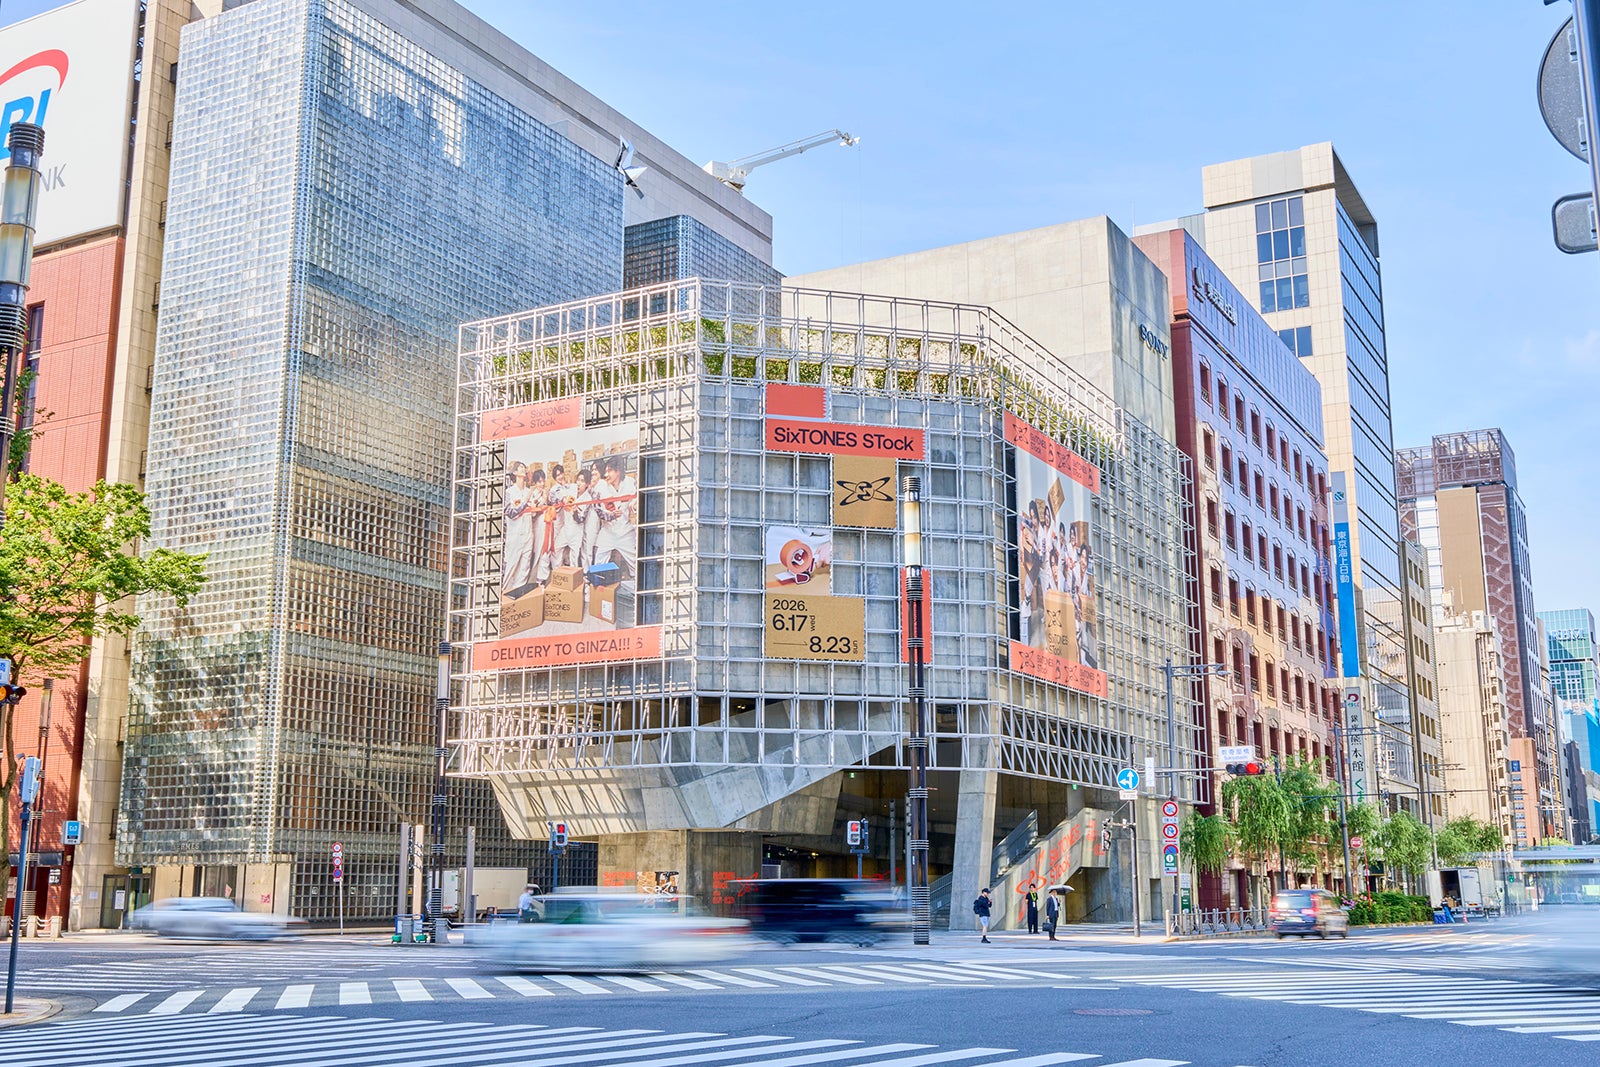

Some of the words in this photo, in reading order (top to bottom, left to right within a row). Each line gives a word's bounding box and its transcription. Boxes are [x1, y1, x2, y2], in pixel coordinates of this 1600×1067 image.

[1139, 323, 1168, 359] SONY
[530, 404, 570, 419] SixTONES
[530, 417, 556, 429] STock
[774, 427, 857, 447] SixTONES
[863, 433, 914, 451] STock
[773, 599, 808, 611] 2026.
[772, 613, 808, 632] 6.17
[491, 645, 551, 662] DELIVERY
[555, 642, 571, 656] TO
[575, 637, 630, 654] GINZA!!!
[809, 636, 851, 654] 8.23
